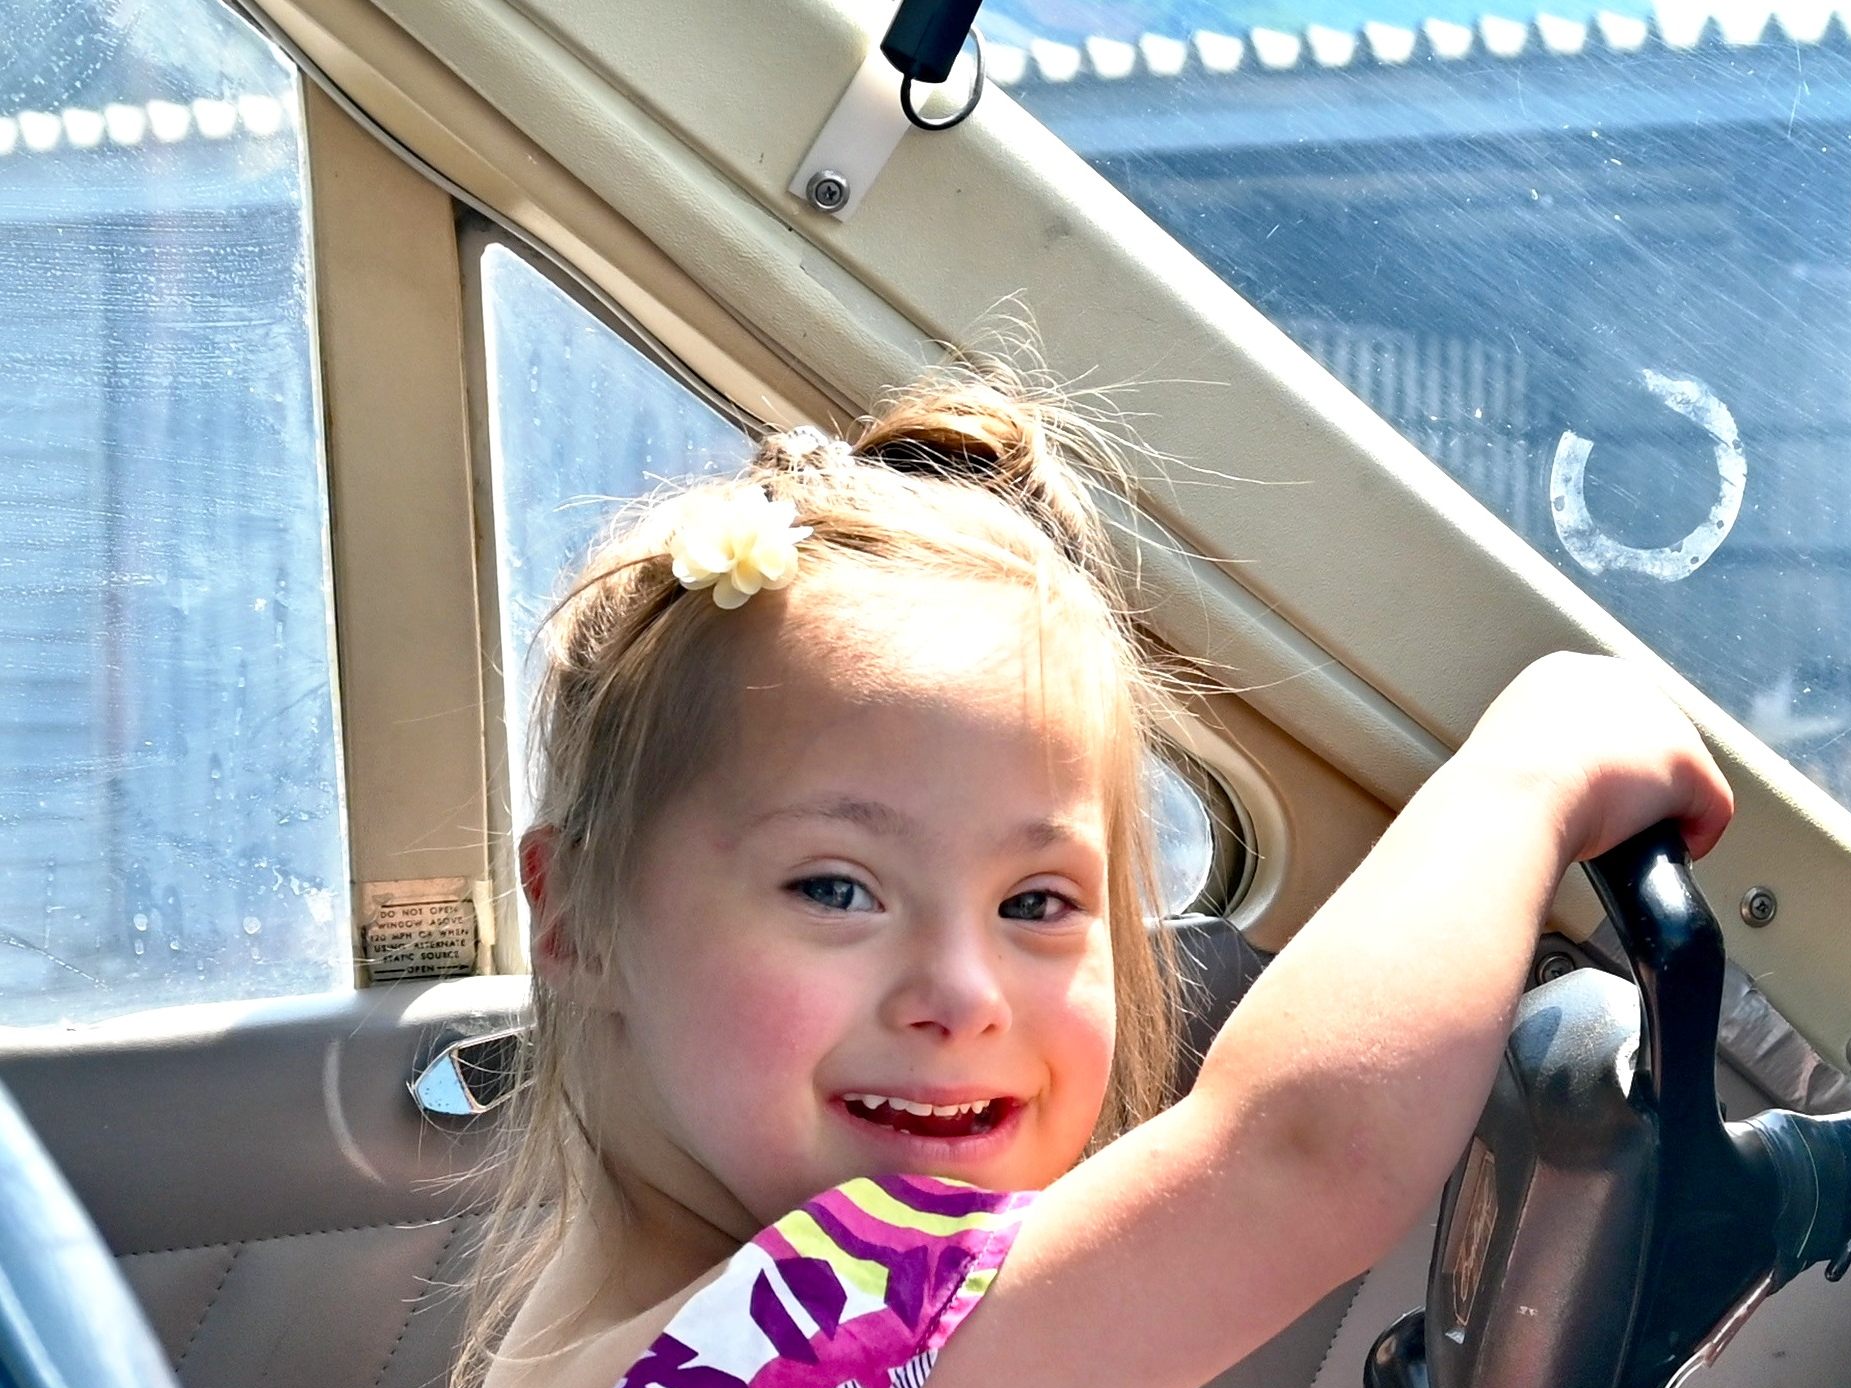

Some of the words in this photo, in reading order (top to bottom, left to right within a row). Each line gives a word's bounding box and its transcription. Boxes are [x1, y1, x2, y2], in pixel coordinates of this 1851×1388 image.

[380, 910, 395, 919] DO
[402, 908, 423, 917] NOT
[430, 905, 458, 915] OPEN
[421, 950, 459, 961] SOURCE
[407, 964, 434, 974] OPEN
